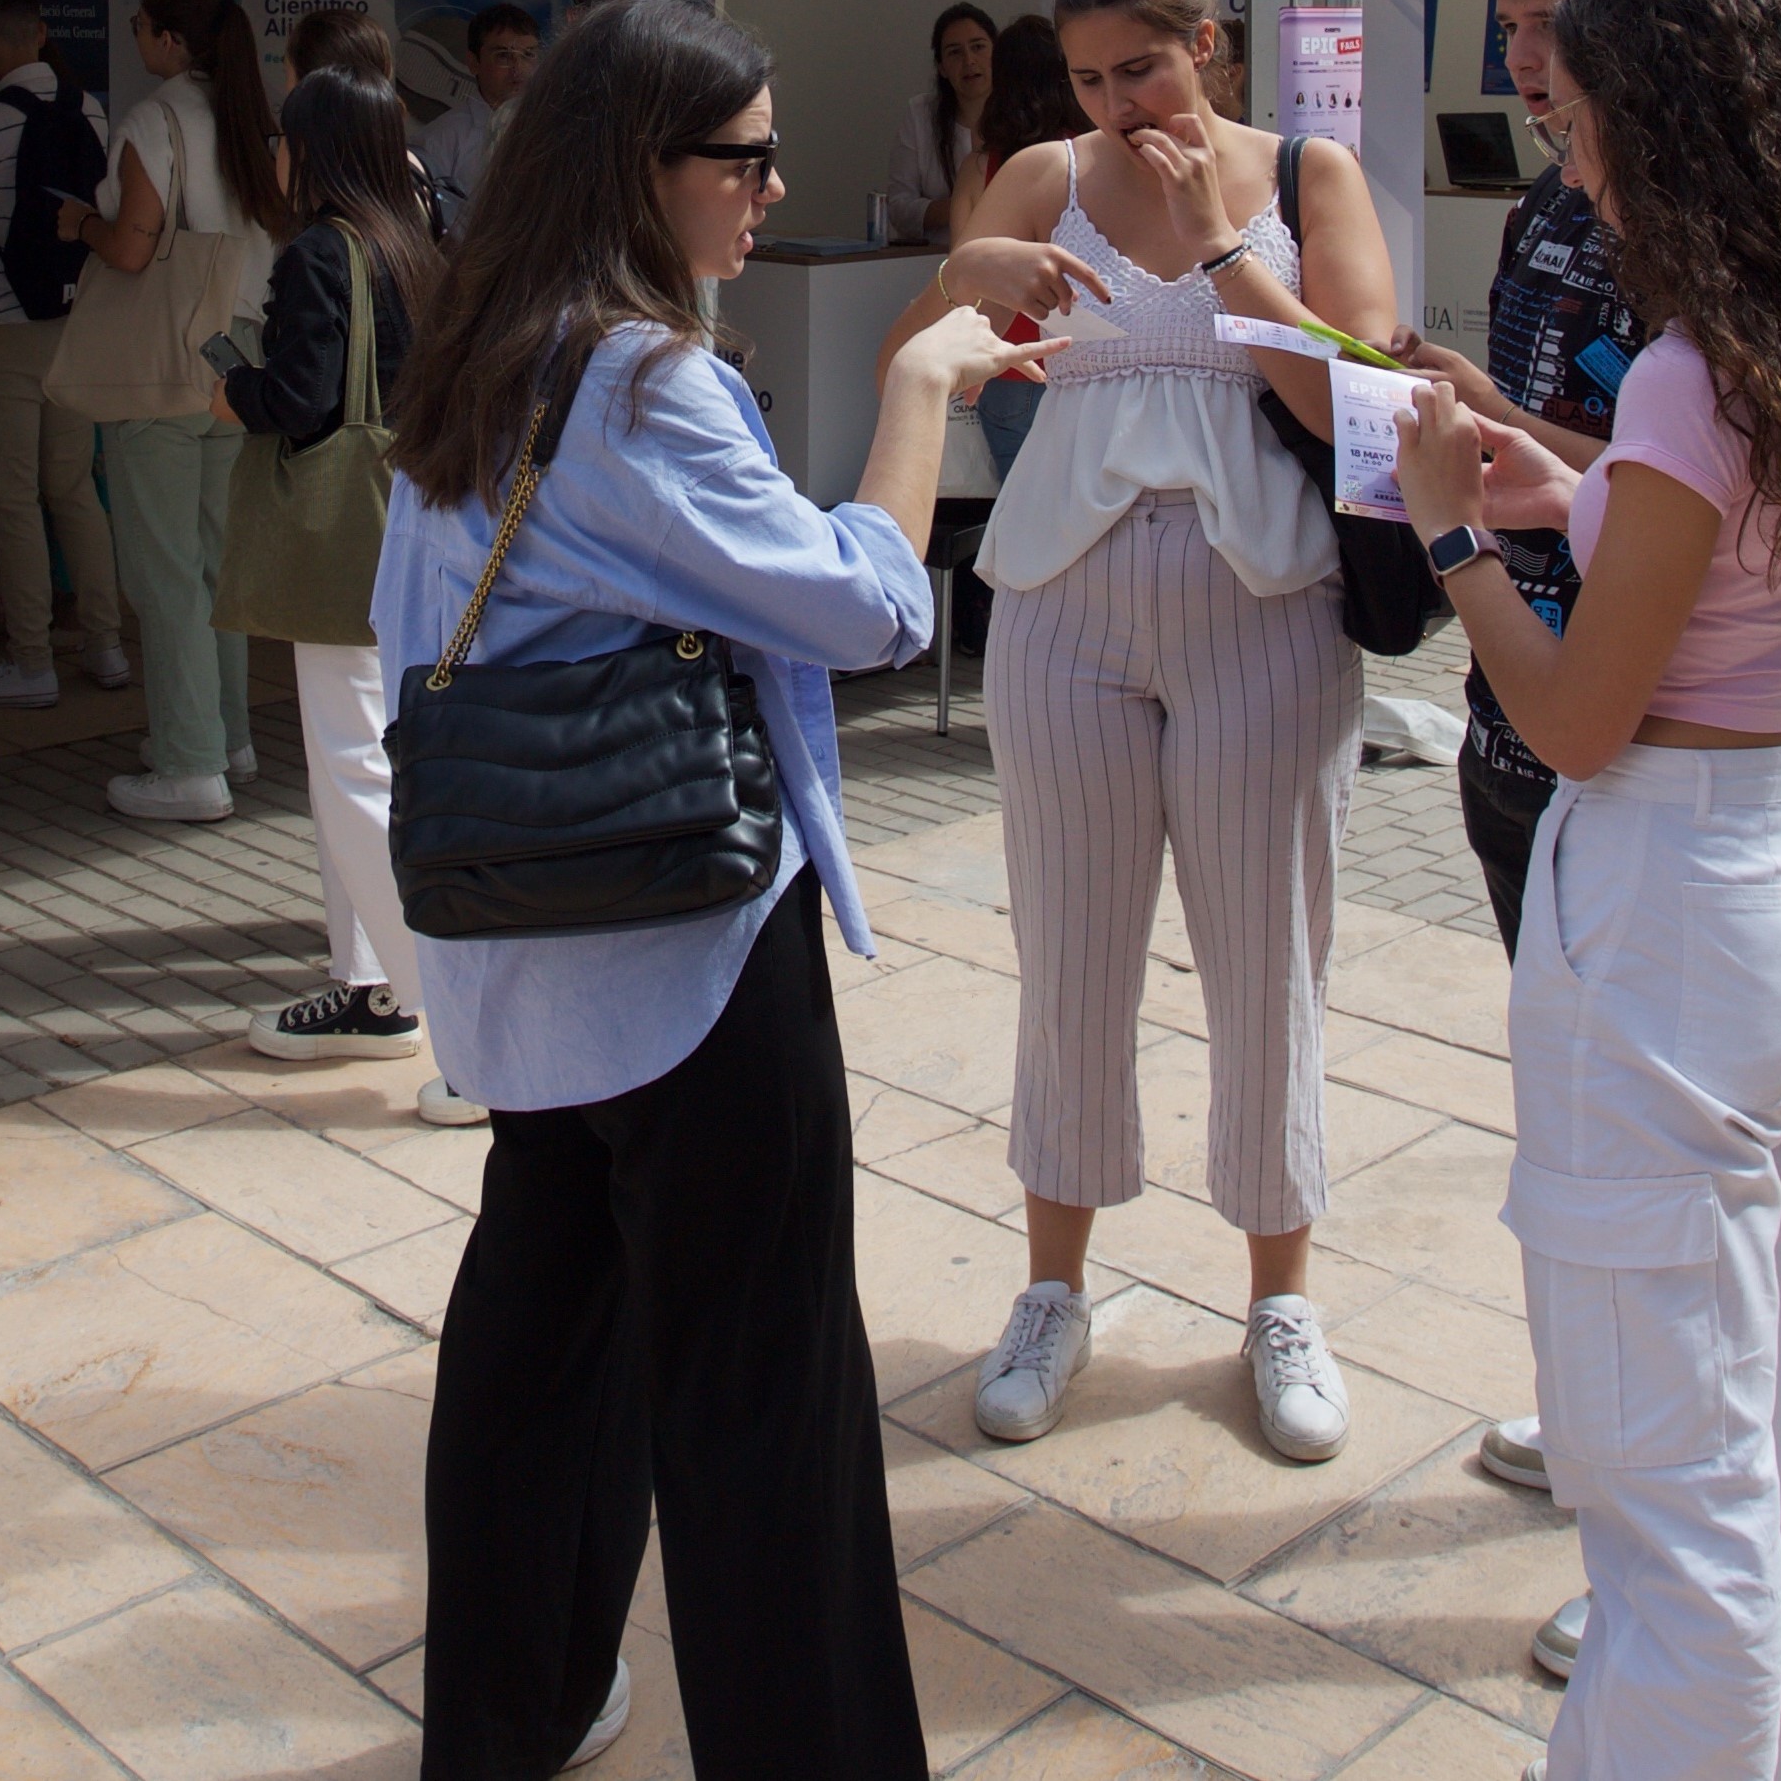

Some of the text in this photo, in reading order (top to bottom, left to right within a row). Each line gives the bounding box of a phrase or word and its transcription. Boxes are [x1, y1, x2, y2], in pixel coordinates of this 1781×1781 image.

[63, 6, 96, 18] General
[73, 27, 105, 39] General
[1301, 37, 1338, 54] EPIC
[1424, 306, 1453, 330] UA
[1349, 381, 1388, 399] EPIC
[1363, 450, 1394, 462] MAYO
